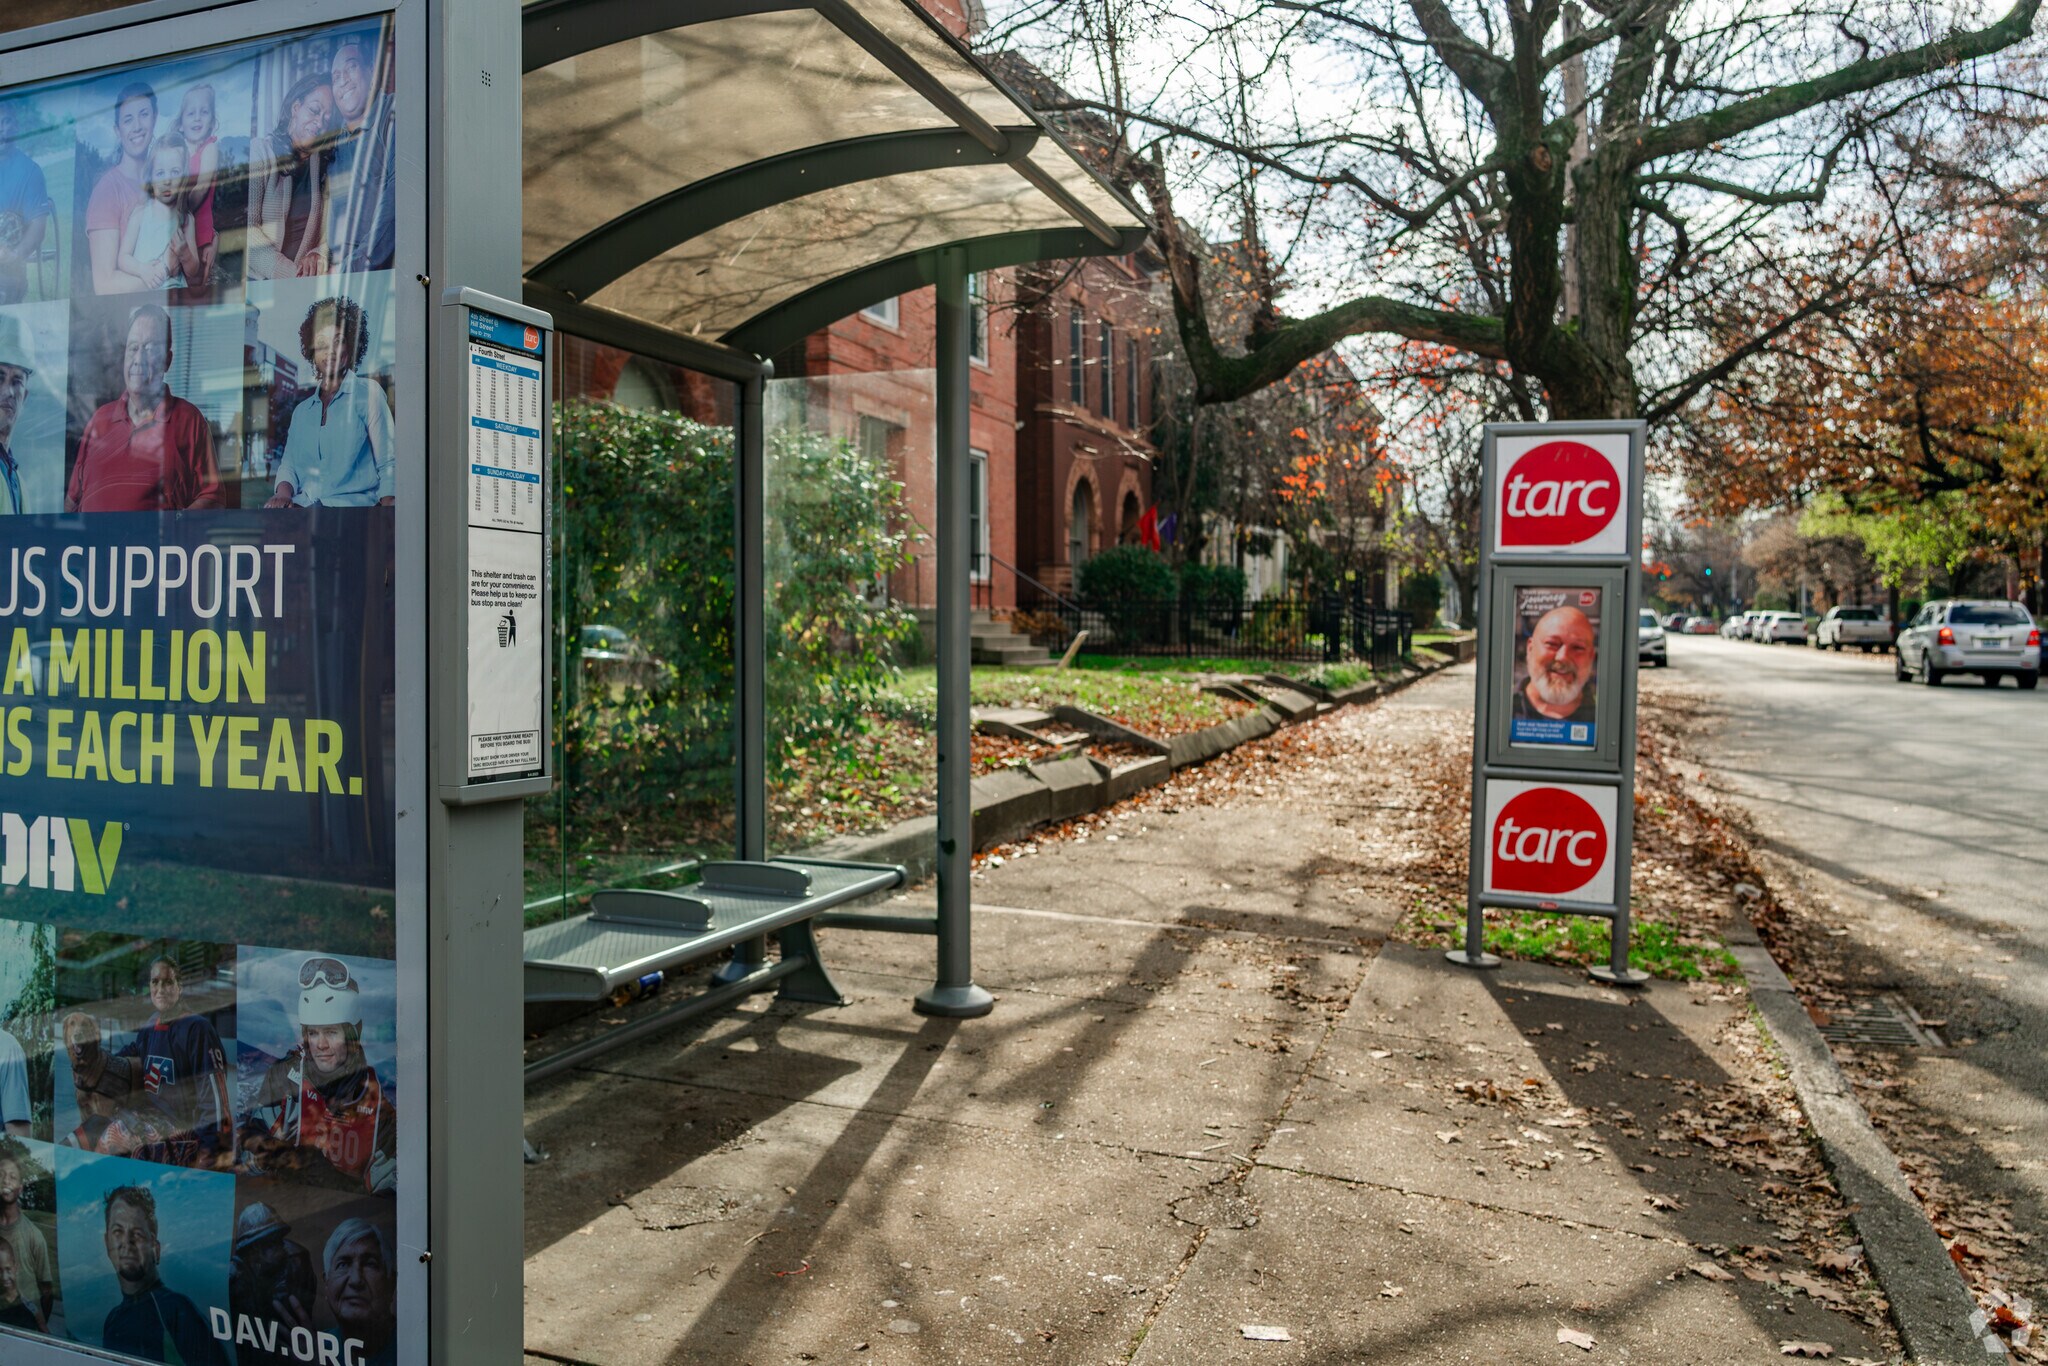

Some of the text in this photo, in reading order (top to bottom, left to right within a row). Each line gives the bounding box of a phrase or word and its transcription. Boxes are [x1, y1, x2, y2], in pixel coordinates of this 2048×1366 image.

[479, 322, 494, 332] Street
[478, 346, 493, 357] Fourth
[494, 350, 506, 361] Street
[495, 361, 517, 373] WEEKDAY
[494, 422, 518, 432] SATURDAY
[486, 468, 526, 479] SUNDAY-HOLIDAY
[1507, 473, 1610, 518] tarc
[471, 569, 482, 578] This
[483, 570, 502, 579] shelter
[0, 544, 296, 619] US SUPPORT
[489, 589, 502, 598] help
[515, 591, 528, 600] keep
[481, 599, 494, 608] stop
[3, 627, 267, 704] A MILLION
[0, 706, 363, 796] S EACH YEAR.
[1497, 817, 1597, 867] tarc
[306, 1089, 318, 1102] VA
[209, 1306, 366, 1366] DAV.ORG
